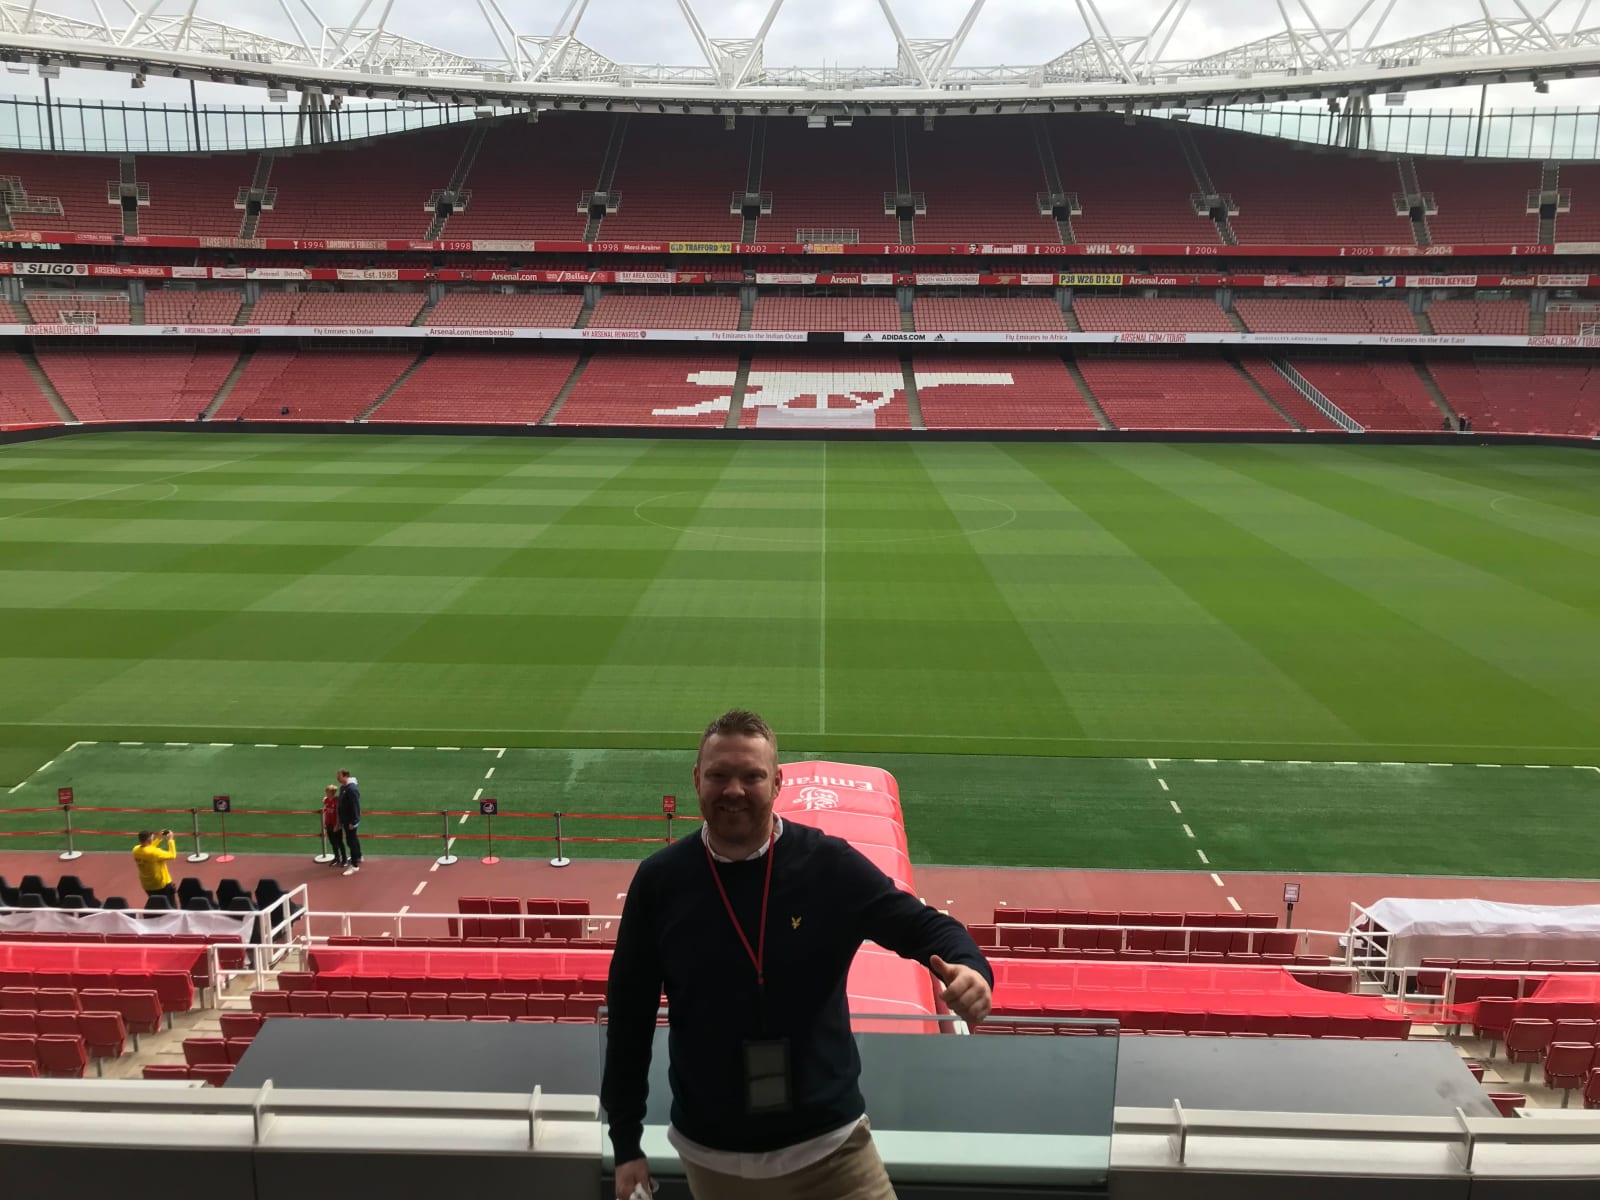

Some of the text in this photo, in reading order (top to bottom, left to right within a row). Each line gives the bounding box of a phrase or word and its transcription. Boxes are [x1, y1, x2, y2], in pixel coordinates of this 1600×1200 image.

[303, 241, 324, 249] 1994
[326, 240, 355, 249] LONDON'S
[450, 242, 471, 250] 1998
[597, 243, 619, 251] 1998
[685, 244, 718, 252] TRAFFORD
[745, 245, 767, 253] 2002
[1086, 244, 1135, 254] WHL '04
[894, 245, 916, 254] 2002
[1044, 246, 1066, 254] 2003
[1195, 246, 1217, 255] 2004
[1351, 247, 1374, 256] 2005
[1424, 246, 1453, 255] 2004
[1525, 246, 1547, 254] 2014
[27, 263, 74, 274] SLIGO
[94, 266, 121, 274] ARSENAL
[491, 272, 538, 281] Arsenal.com
[830, 275, 859, 284] Arsenal
[1060, 275, 1074, 283] P38
[1077, 275, 1093, 283] W26
[1096, 275, 1110, 283] D12
[1129, 276, 1177, 285] Arsenal.com
[1418, 277, 1476, 285] MILTON KEYNES
[1500, 276, 1535, 285] Arsenal
[24, 325, 100, 334] ARSENALDIRECT.COM
[429, 328, 515, 336] Arsenal.com/membership
[1120, 333, 1186, 343] ARSENAL.COM/TOURS
